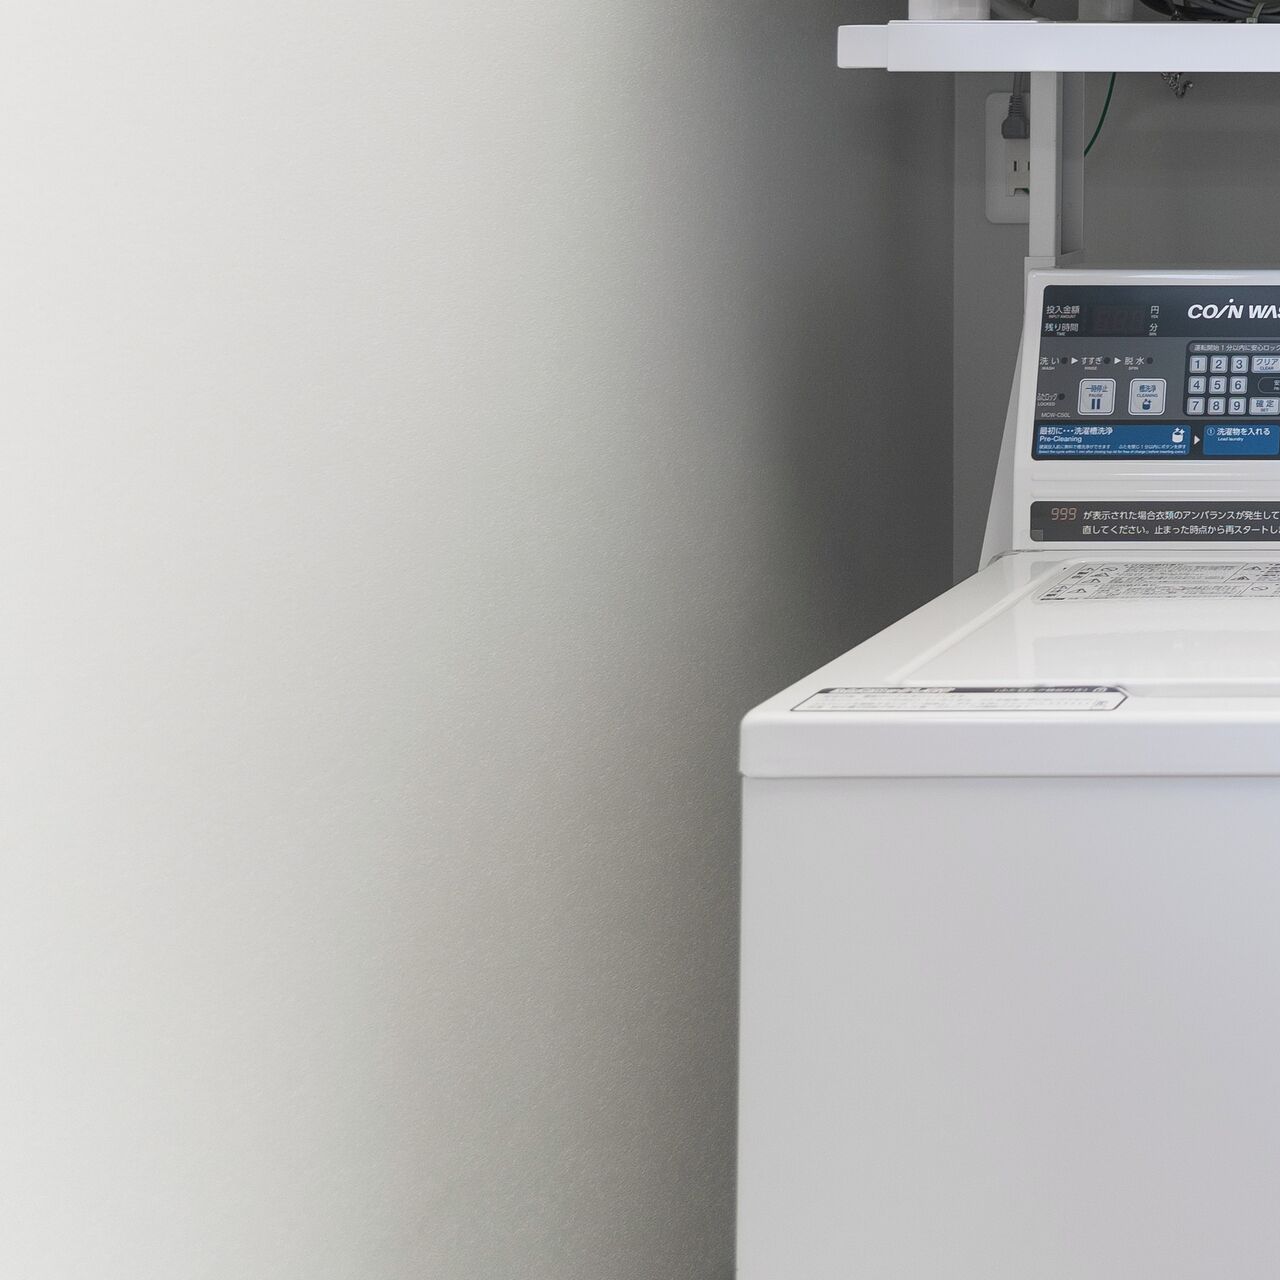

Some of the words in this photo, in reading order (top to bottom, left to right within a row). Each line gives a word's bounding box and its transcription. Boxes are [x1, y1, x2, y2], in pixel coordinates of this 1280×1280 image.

[1047, 306, 1080, 314] 投入金額
[1151, 306, 1159, 314] 円
[1188, 299, 1243, 319] COIN
[1045, 323, 1079, 332] 残り時間
[1150, 323, 1157, 331] 分
[1040, 357, 1059, 365] 洗い
[1081, 357, 1103, 365] すすぎ
[1125, 357, 1144, 365] 脱水
[1195, 360, 1200, 368] 1
[1215, 360, 1222, 368] 2
[1236, 360, 1242, 368] 3
[1086, 385, 1108, 393] 一時停止
[1139, 385, 1156, 393] 槽洗浄
[1194, 381, 1201, 389] 4
[1214, 381, 1221, 389] 5
[1235, 381, 1241, 389] 6
[1192, 402, 1199, 410] 7
[1213, 402, 1219, 410] 8
[1233, 402, 1240, 410] 9
[1256, 400, 1274, 408] 確定
[1217, 428, 1270, 436] 洗濯物を入れる
